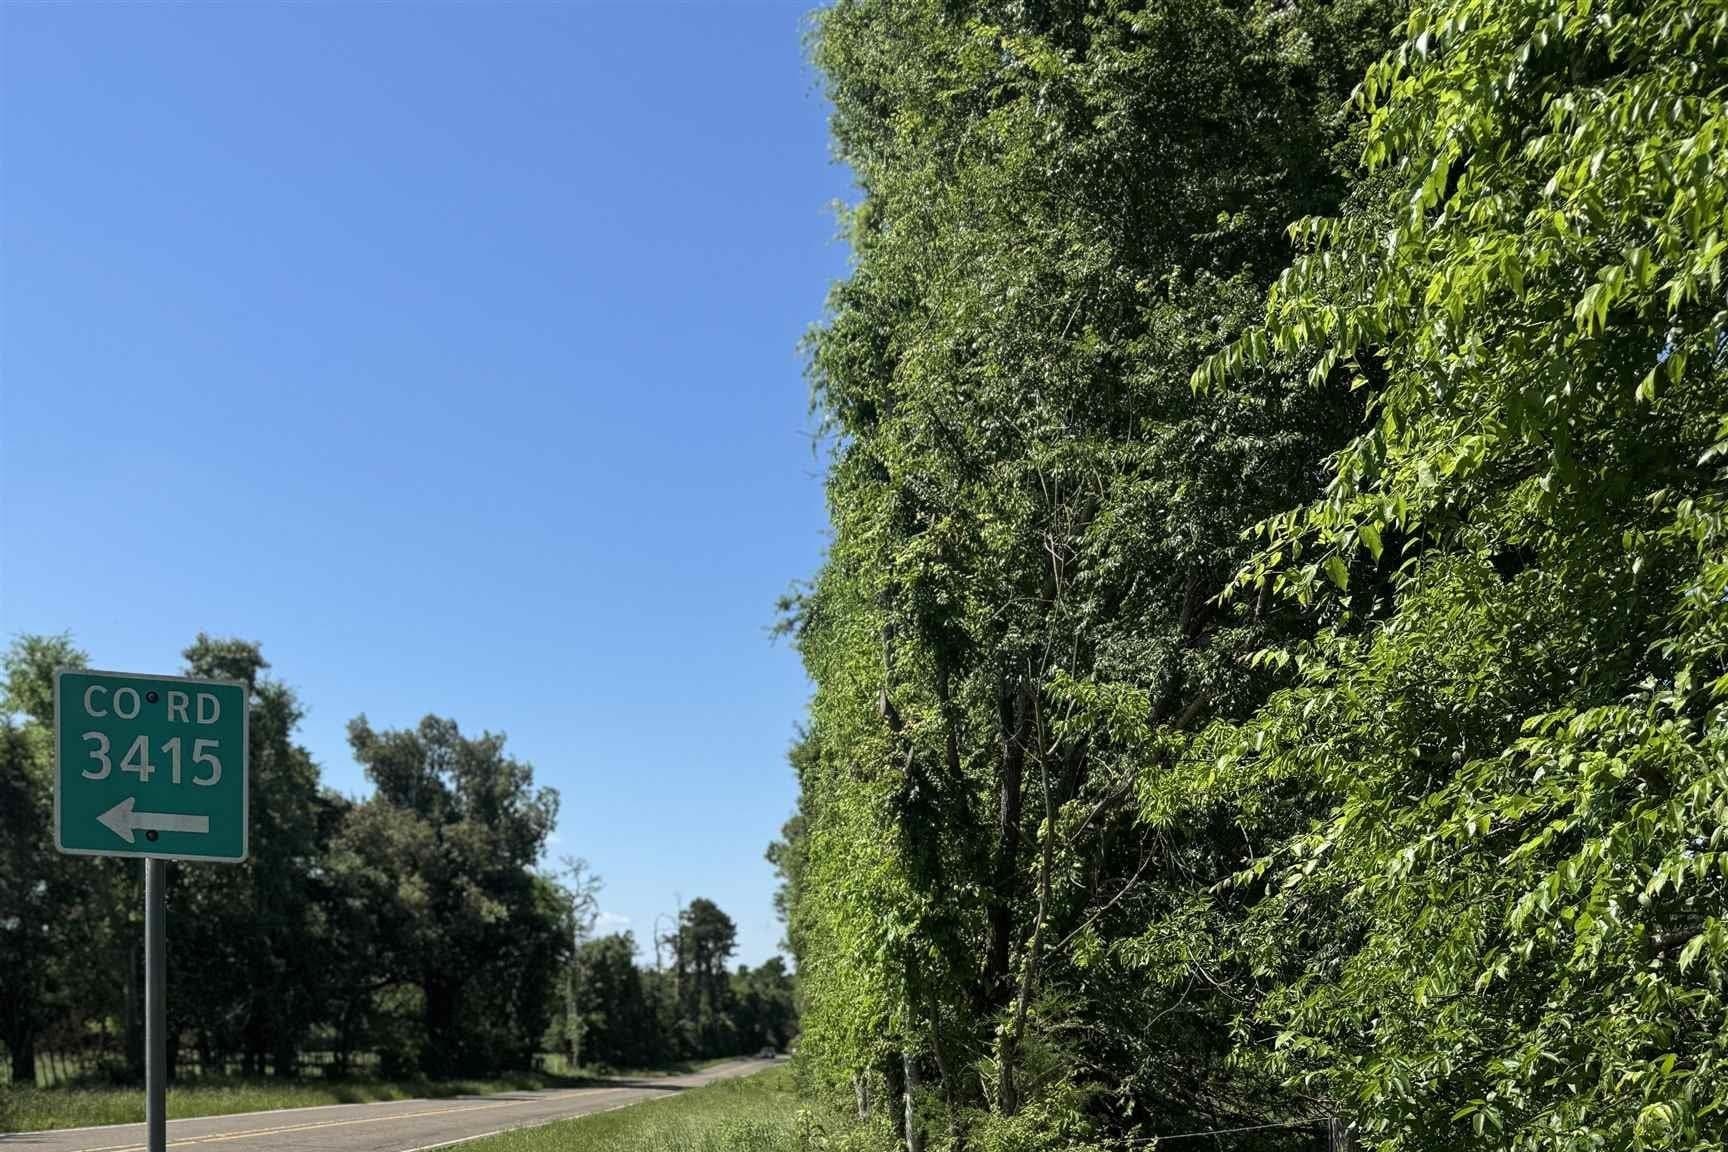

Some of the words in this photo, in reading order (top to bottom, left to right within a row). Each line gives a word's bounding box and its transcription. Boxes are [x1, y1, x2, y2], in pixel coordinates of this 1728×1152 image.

[83, 685, 141, 720] CO
[167, 691, 221, 724] RD
[81, 731, 222, 786] 3415
